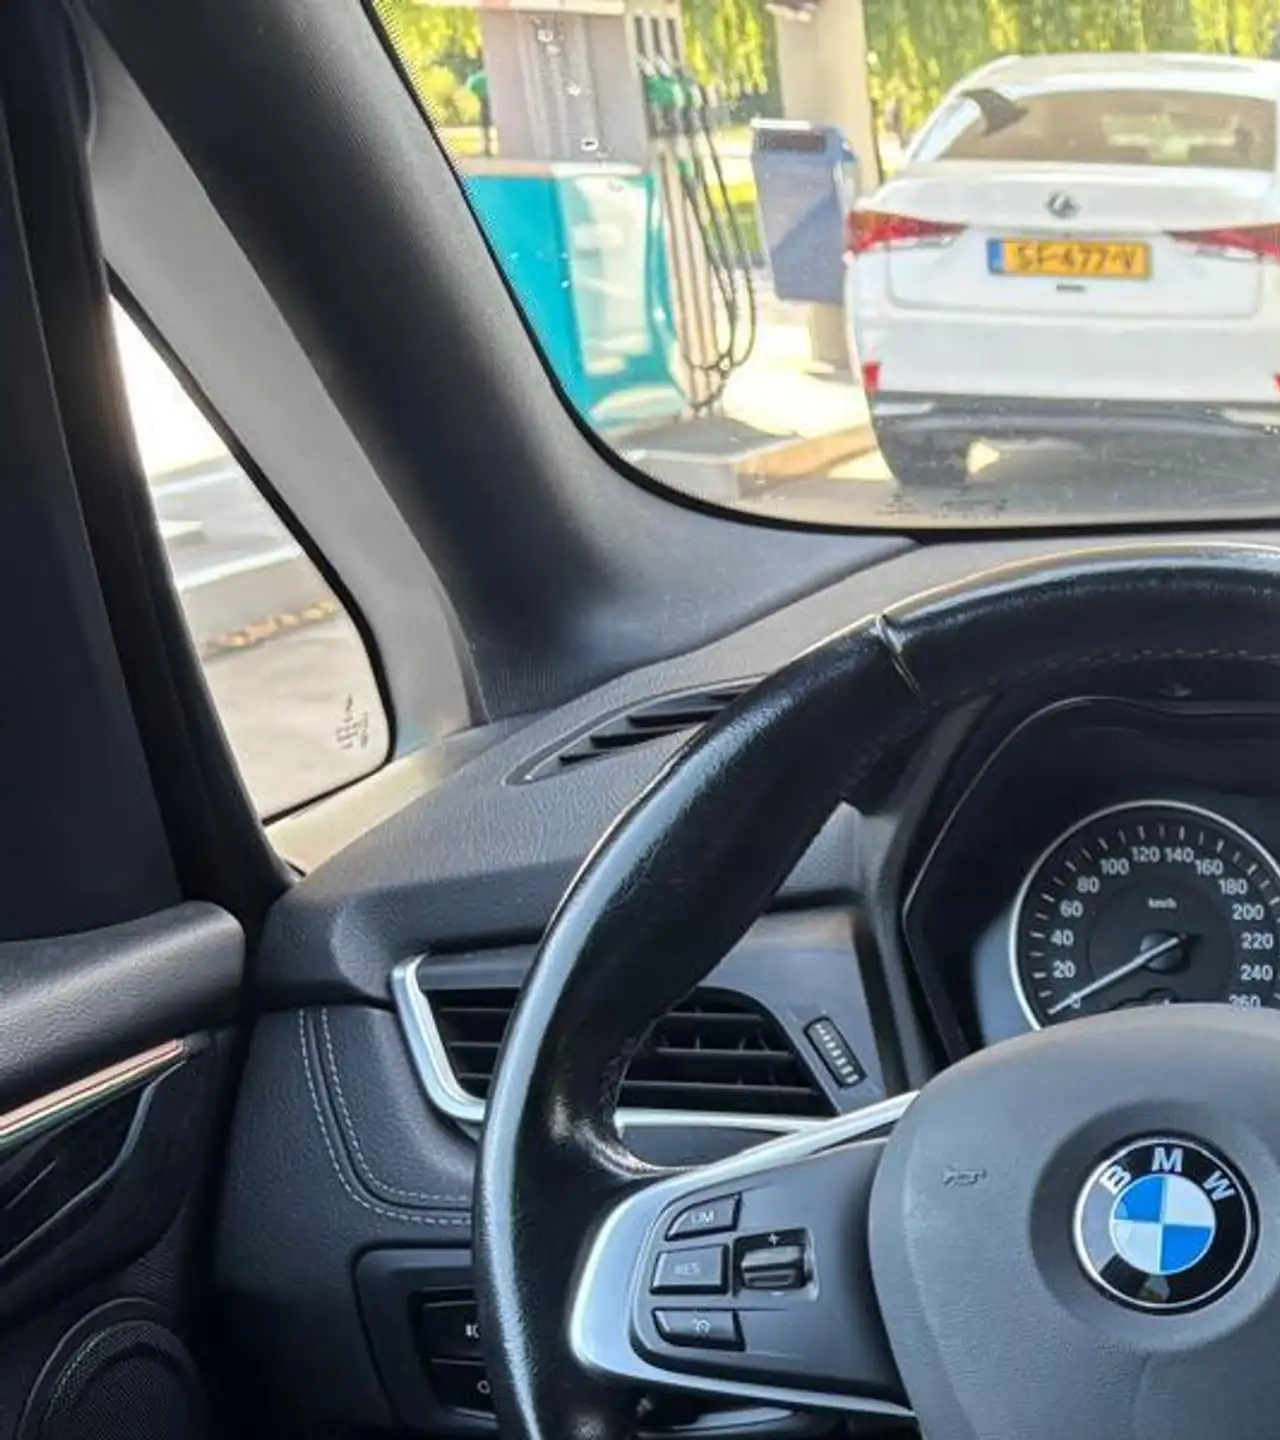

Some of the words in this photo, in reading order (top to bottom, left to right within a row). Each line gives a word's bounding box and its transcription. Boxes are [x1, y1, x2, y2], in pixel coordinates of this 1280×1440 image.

[1132, 847, 1160, 862] 120
[1164, 848, 1195, 862] 140
[1100, 859, 1130, 875] 100
[1194, 860, 1224, 876] 160
[1077, 877, 1100, 893] 80
[1218, 878, 1248, 895] 180
[1060, 901, 1083, 917] 60
[1232, 904, 1265, 921] 200
[1051, 930, 1074, 946] 40
[1240, 933, 1274, 949] 220
[1053, 962, 1076, 978] 20
[1240, 965, 1273, 981] 240
[1099, 1146, 1236, 1202] BMW
